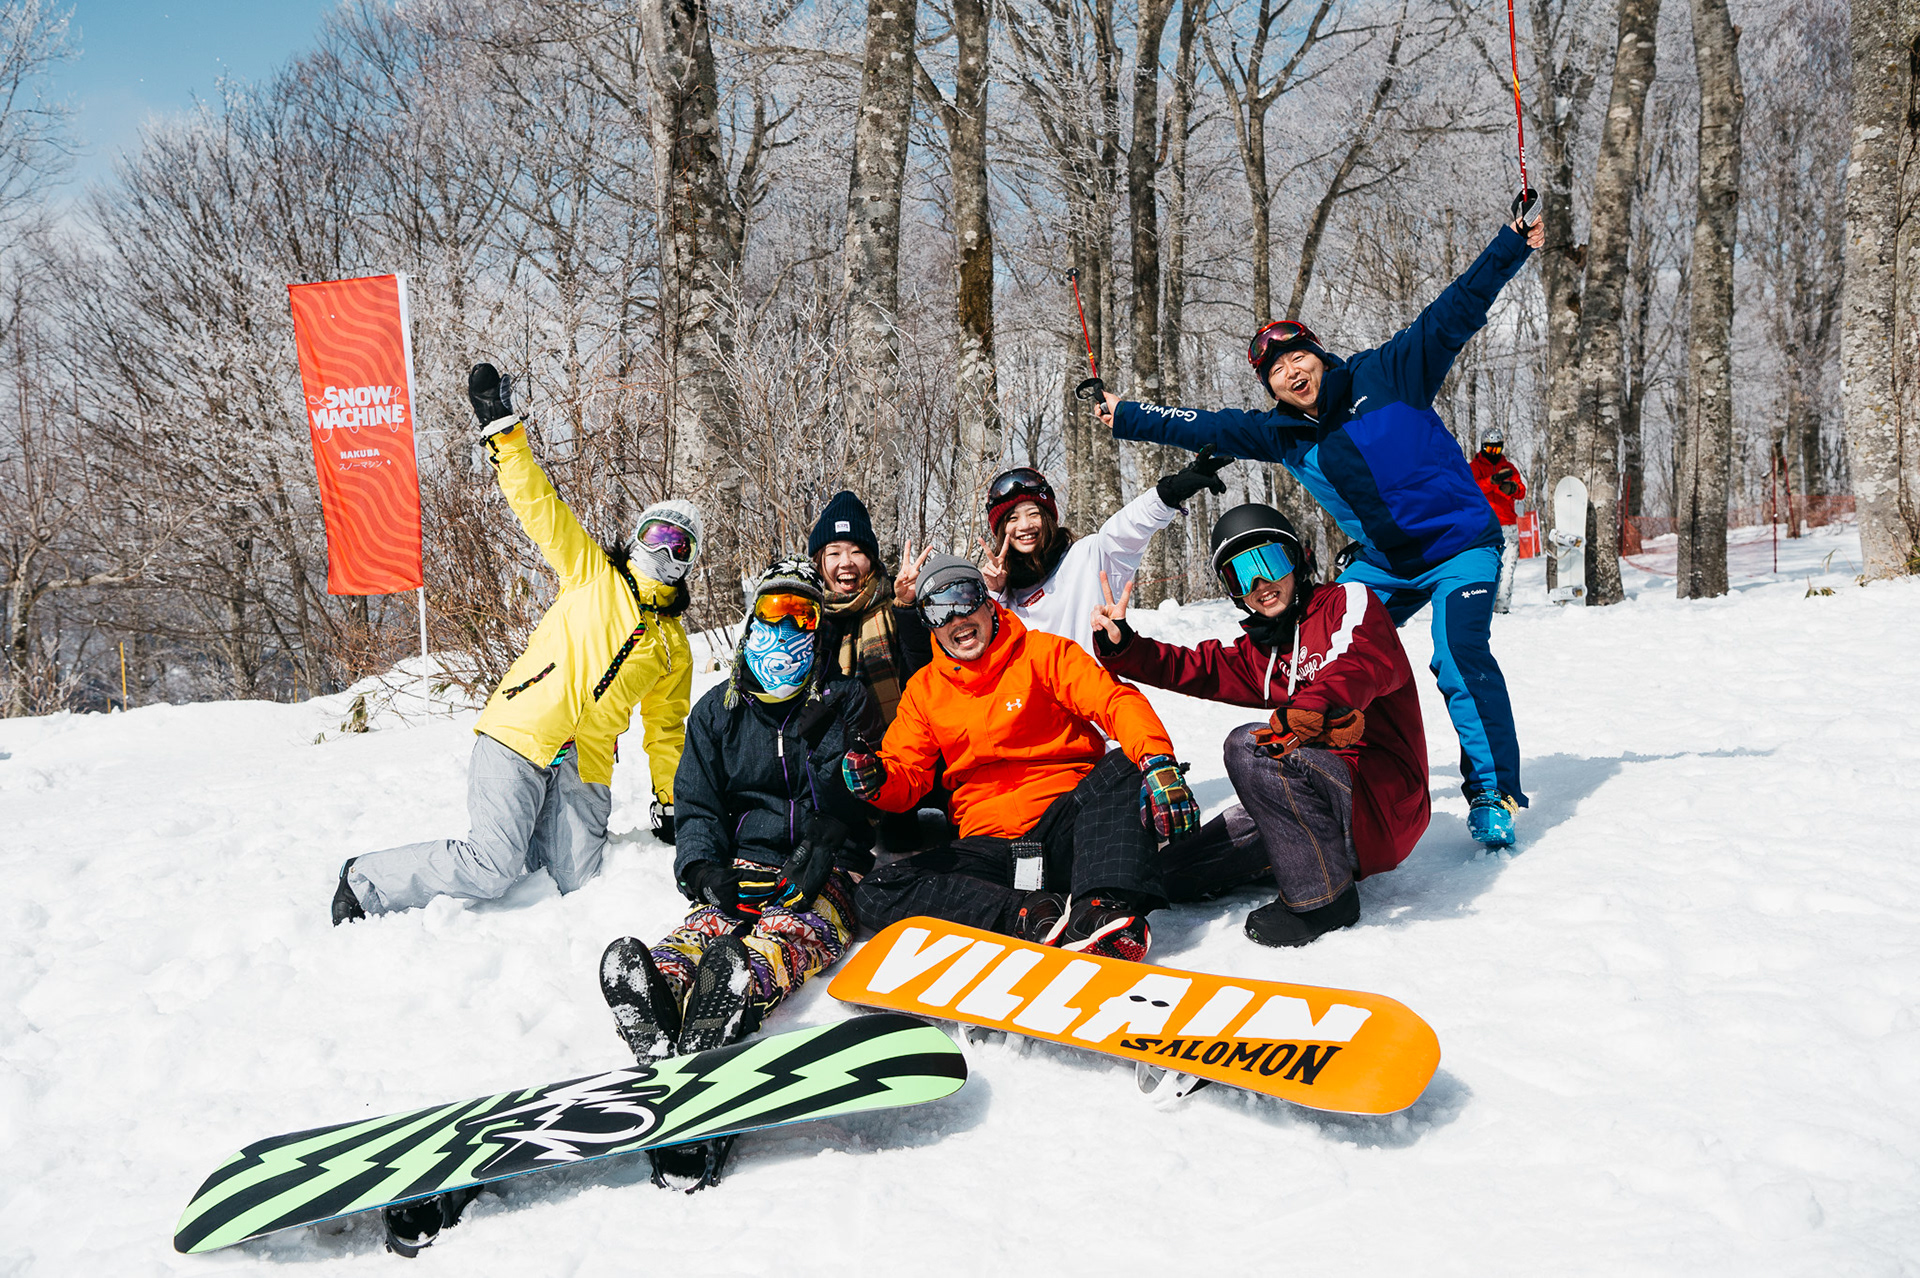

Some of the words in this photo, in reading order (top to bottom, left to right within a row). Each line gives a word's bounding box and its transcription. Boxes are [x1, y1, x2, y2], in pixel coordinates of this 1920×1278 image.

[322, 385, 394, 409] SNOW
[311, 404, 406, 430] MACHINE
[1139, 402, 1198, 422] Goldwin
[340, 448, 380, 459] HAKUBA
[339, 461, 383, 471] スノーマシン
[866, 927, 1372, 1043] VILLAIN
[1120, 1037, 1342, 1085] SALOMON
